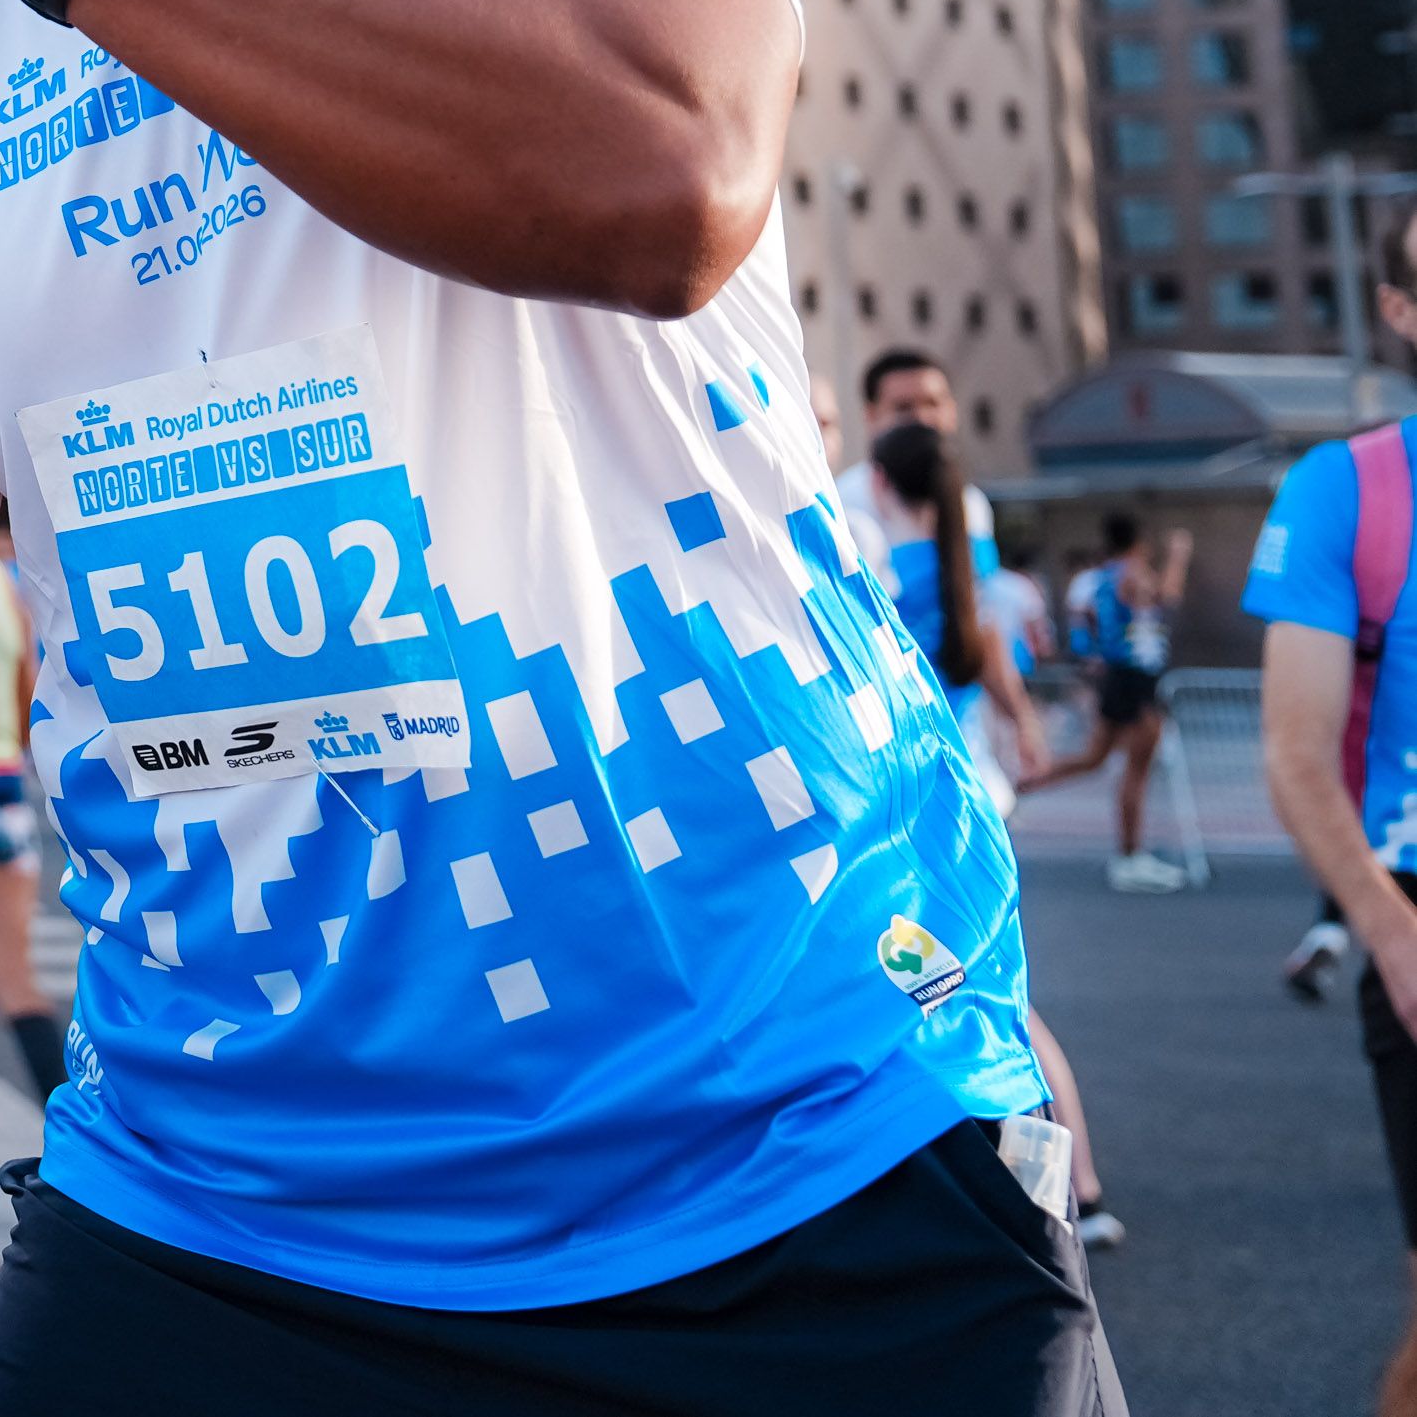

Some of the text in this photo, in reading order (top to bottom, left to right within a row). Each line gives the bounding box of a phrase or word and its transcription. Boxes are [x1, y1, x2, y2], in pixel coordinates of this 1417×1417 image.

[61, 172, 197, 258] Run
[131, 184, 266, 286] 21.02026
[61, 375, 359, 459] KLM Royal Dutch Airlines
[77, 418, 369, 513] NORTE VS SUR
[85, 517, 429, 683] 5102
[158, 715, 460, 770] BM SKECHERS KLM MADRID
